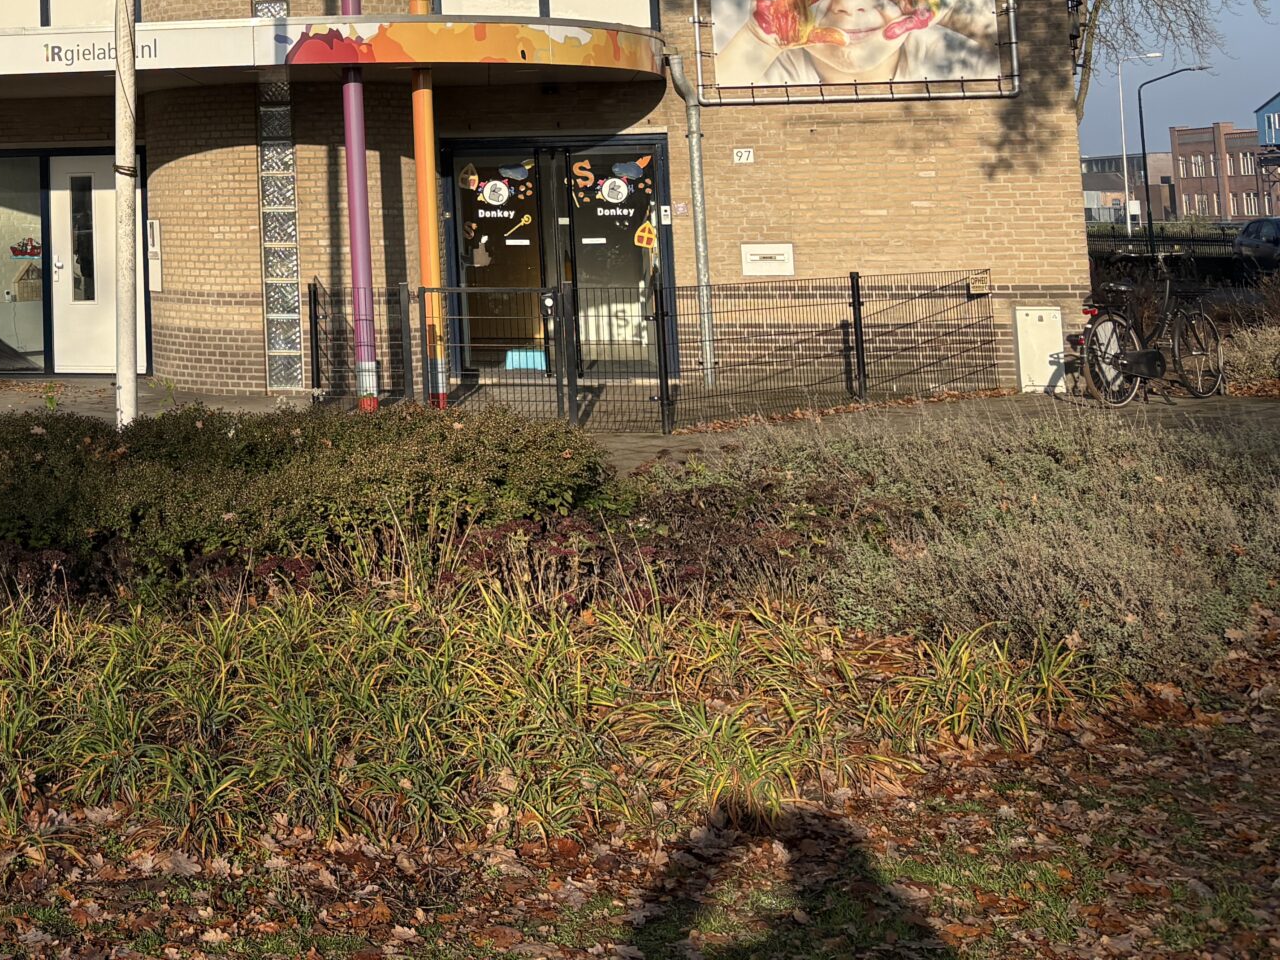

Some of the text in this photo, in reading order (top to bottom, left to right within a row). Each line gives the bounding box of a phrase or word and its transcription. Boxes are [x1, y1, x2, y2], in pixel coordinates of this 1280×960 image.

[735, 150, 751, 161] 97
[478, 209, 515, 219] Donkey
[597, 207, 635, 217] Donkey
